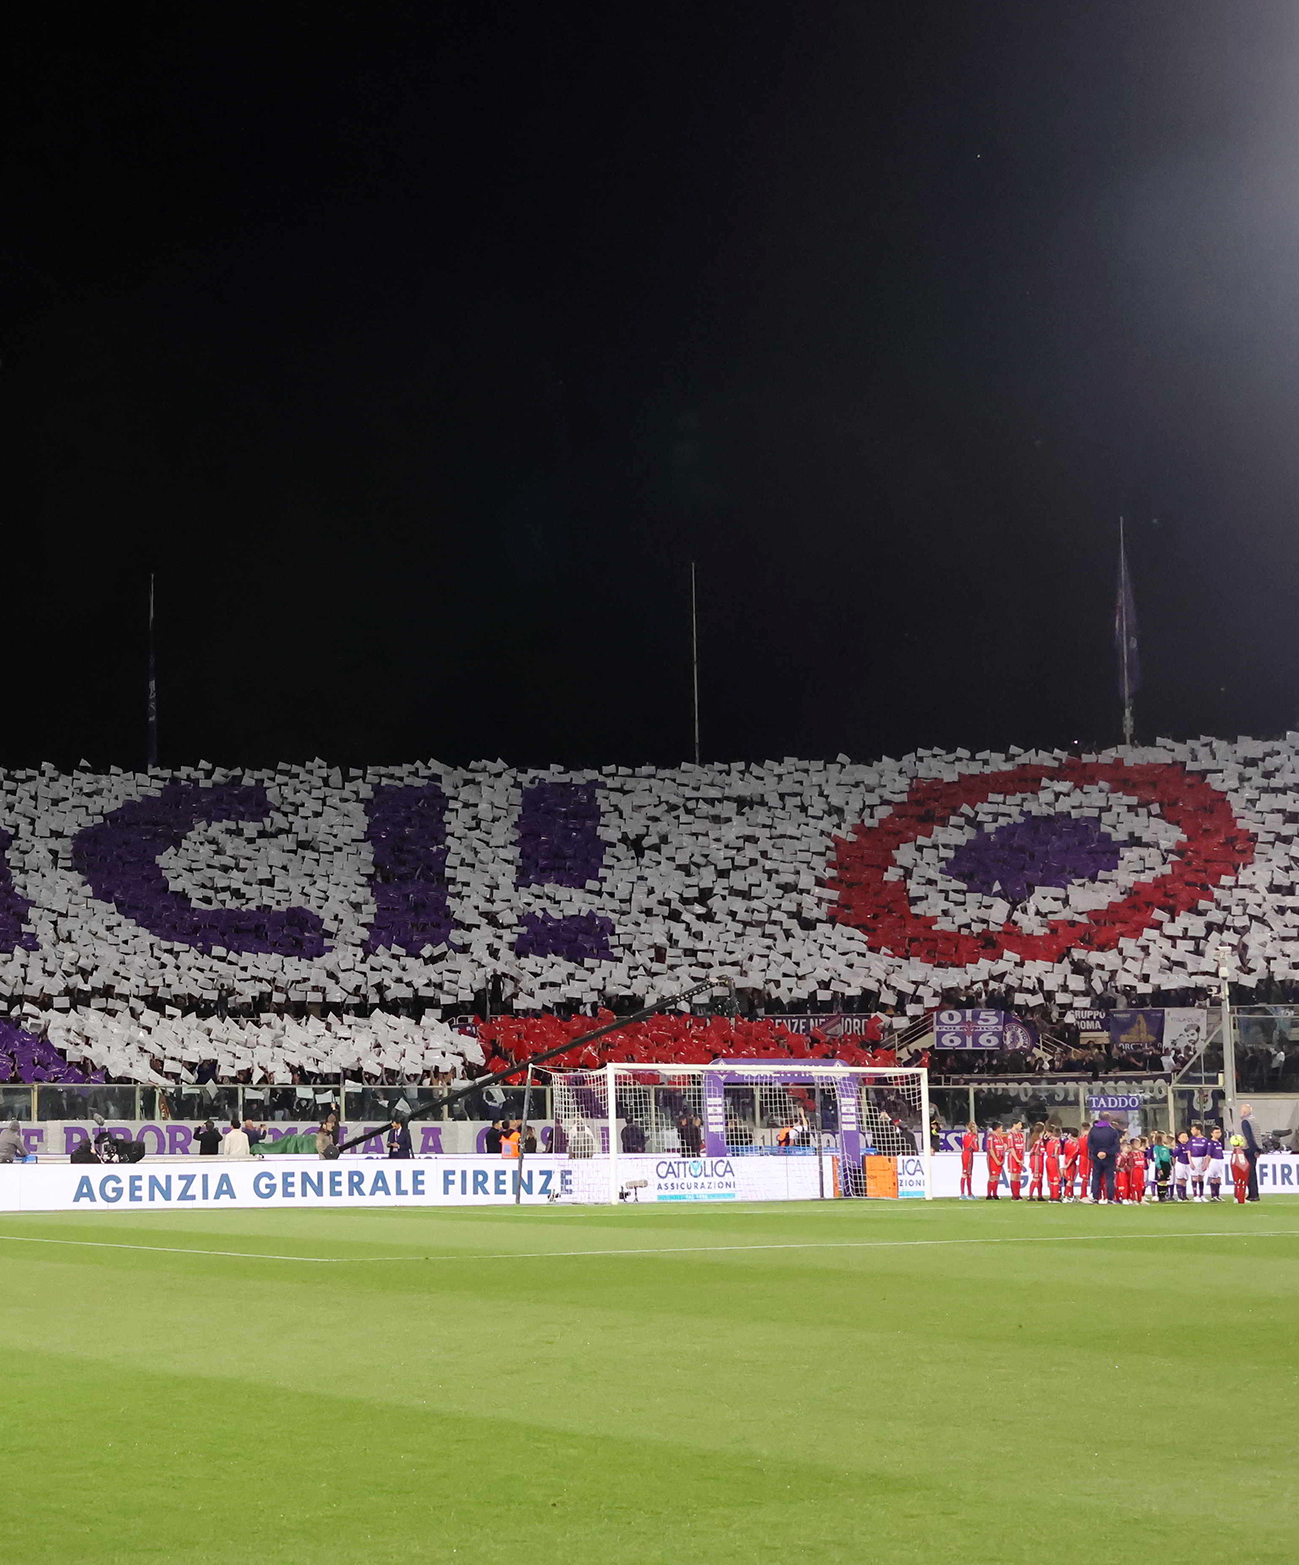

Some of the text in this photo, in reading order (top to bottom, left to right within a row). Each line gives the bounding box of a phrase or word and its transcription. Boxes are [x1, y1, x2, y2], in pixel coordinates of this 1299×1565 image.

[1089, 1096, 1139, 1108] TADDO
[655, 1159, 735, 1179] CATTOLICA
[73, 1168, 573, 1203] AGENZIA GENERALE FIRENZE
[656, 1180, 736, 1190] ASSICURAZIONI
